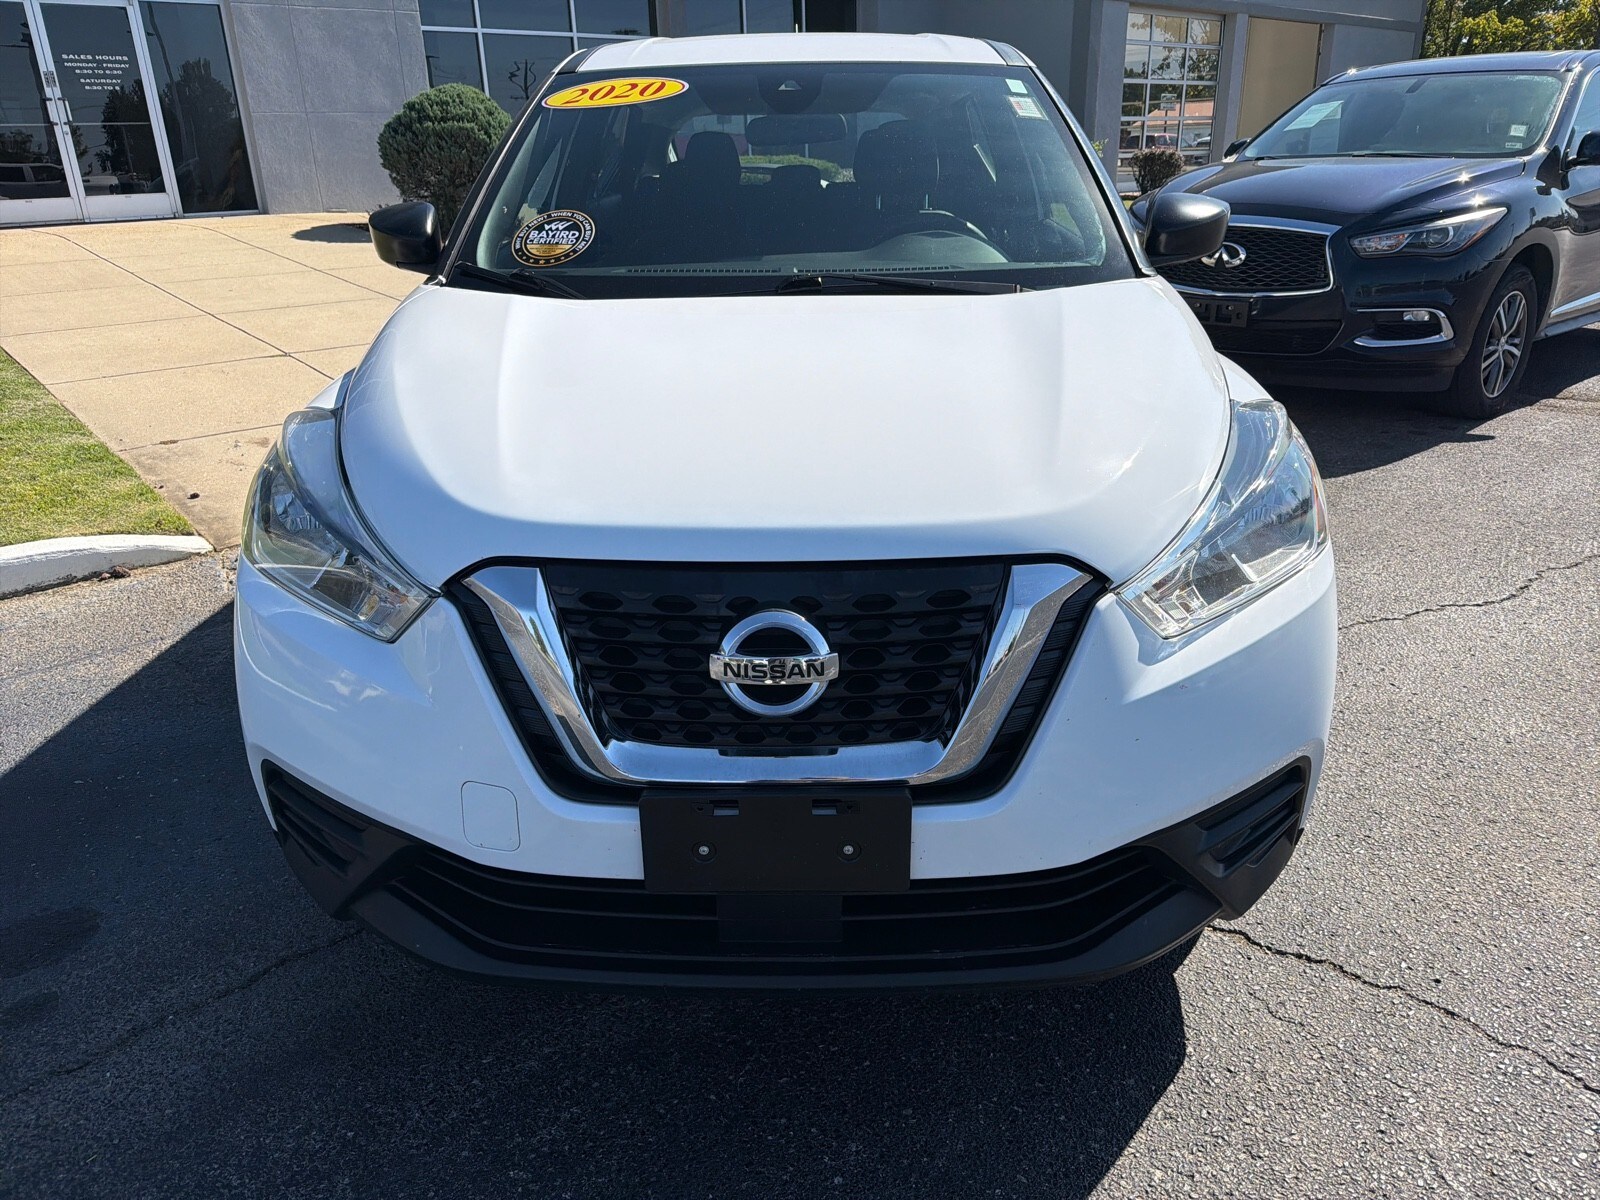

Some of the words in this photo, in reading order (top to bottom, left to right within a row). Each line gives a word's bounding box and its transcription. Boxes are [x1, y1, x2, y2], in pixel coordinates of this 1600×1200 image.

[560, 81, 666, 105] 2020
[518, 227, 529, 237] BUY
[529, 216, 548, 227] NEW?
[573, 212, 586, 222] YOU
[583, 220, 592, 231] CAN
[528, 230, 579, 239] BAYIRD
[723, 662, 825, 679] NISSAN
